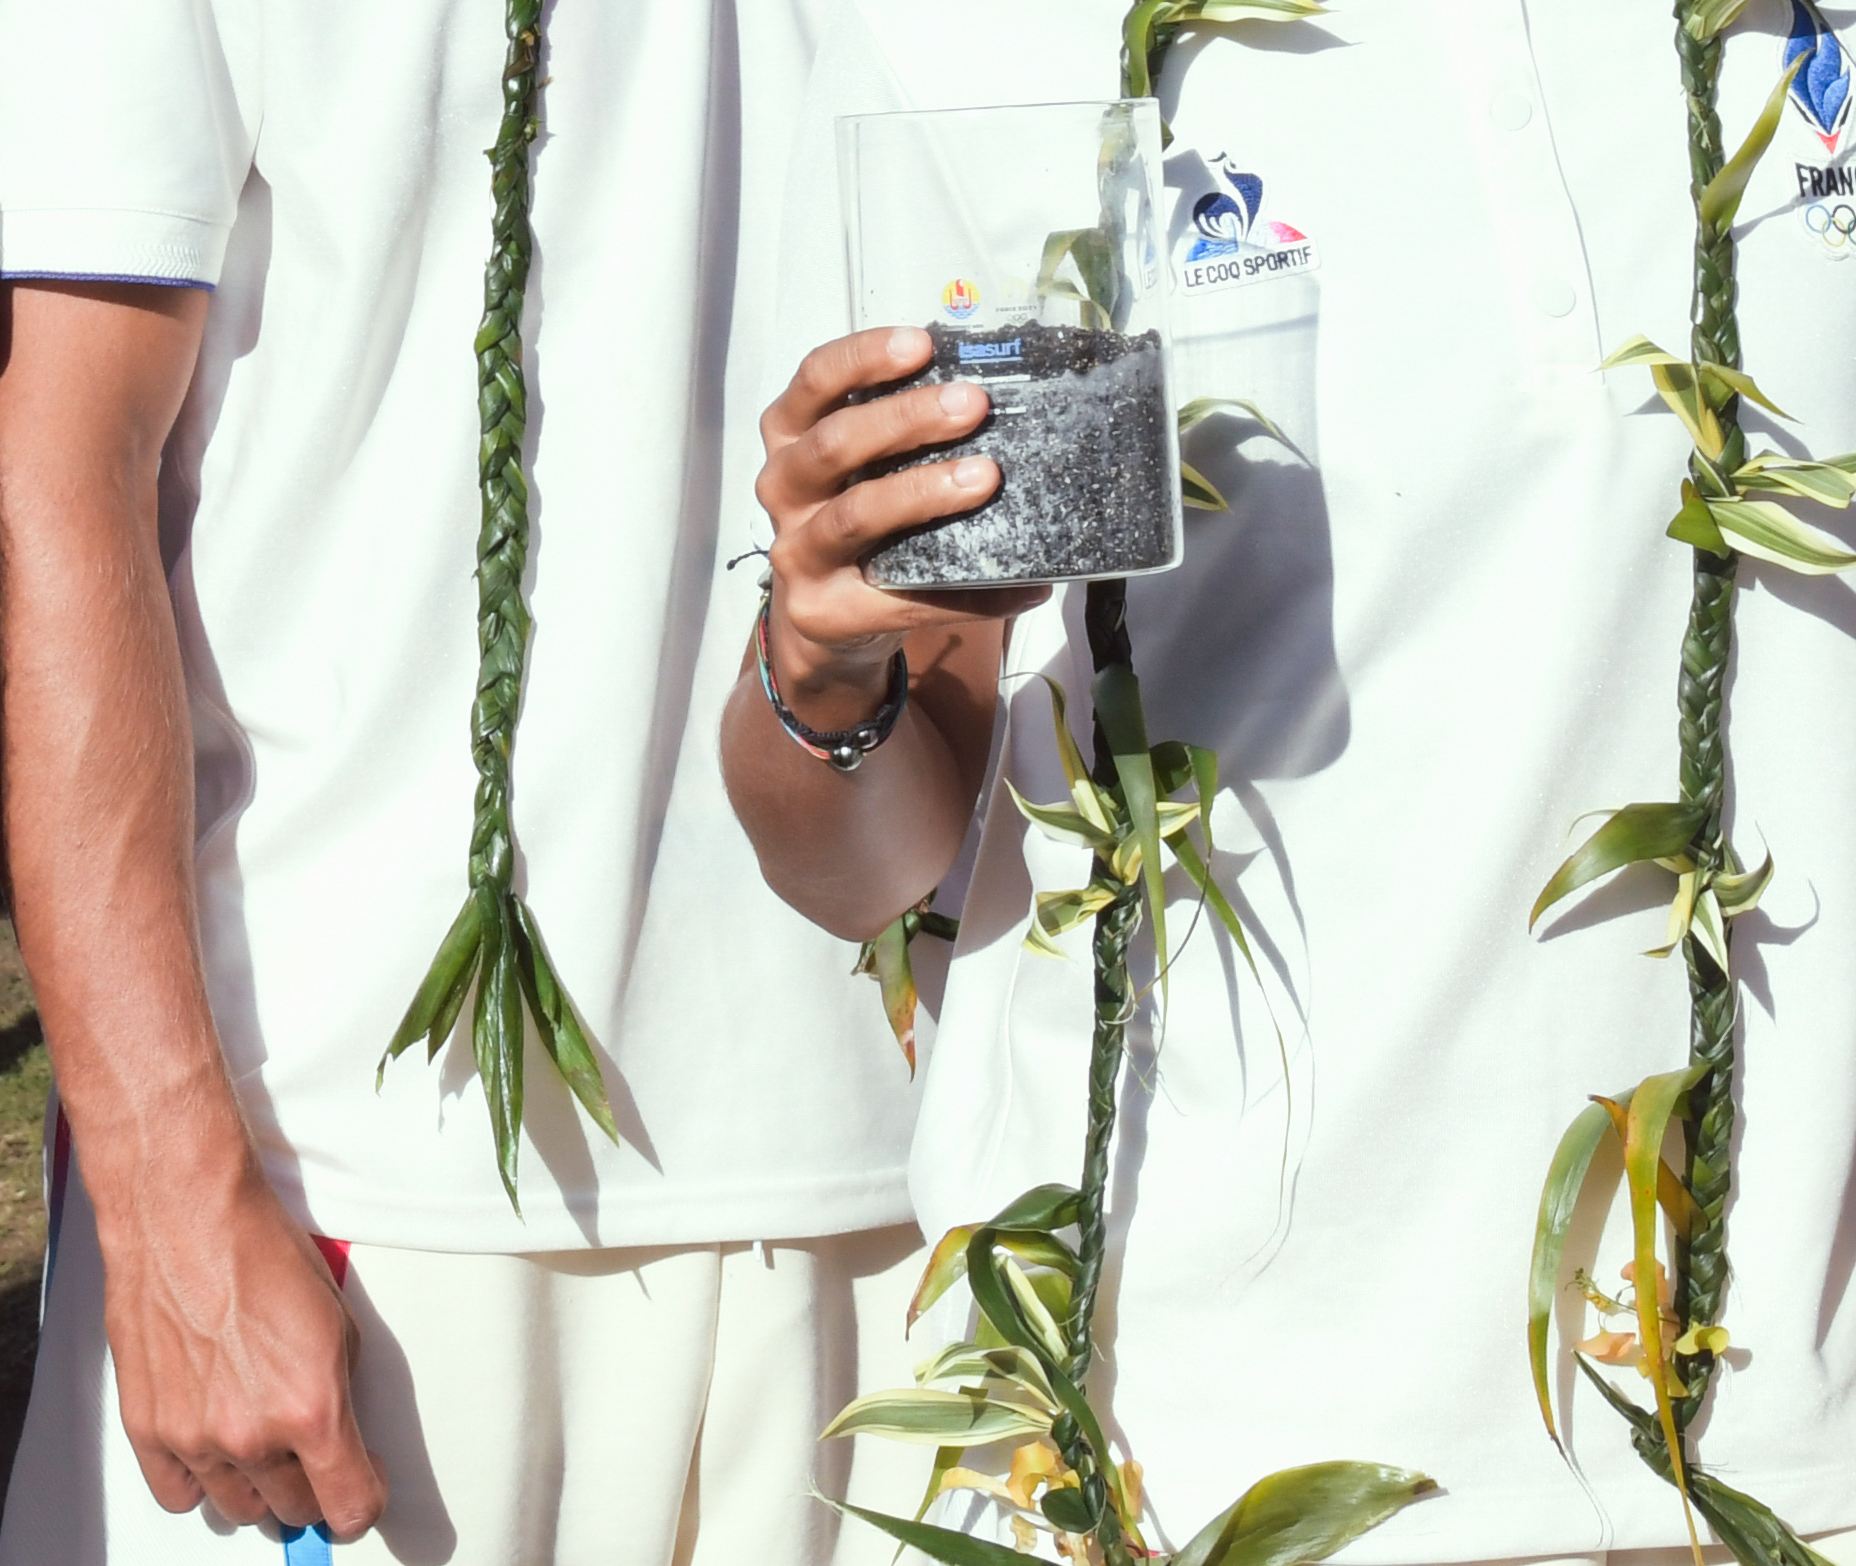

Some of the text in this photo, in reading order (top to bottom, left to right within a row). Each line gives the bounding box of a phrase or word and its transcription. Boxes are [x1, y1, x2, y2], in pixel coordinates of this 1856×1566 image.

[1184, 268, 1206, 288] LE
[1206, 260, 1242, 284] COQ
[1243, 245, 1312, 276] SPORTIF
